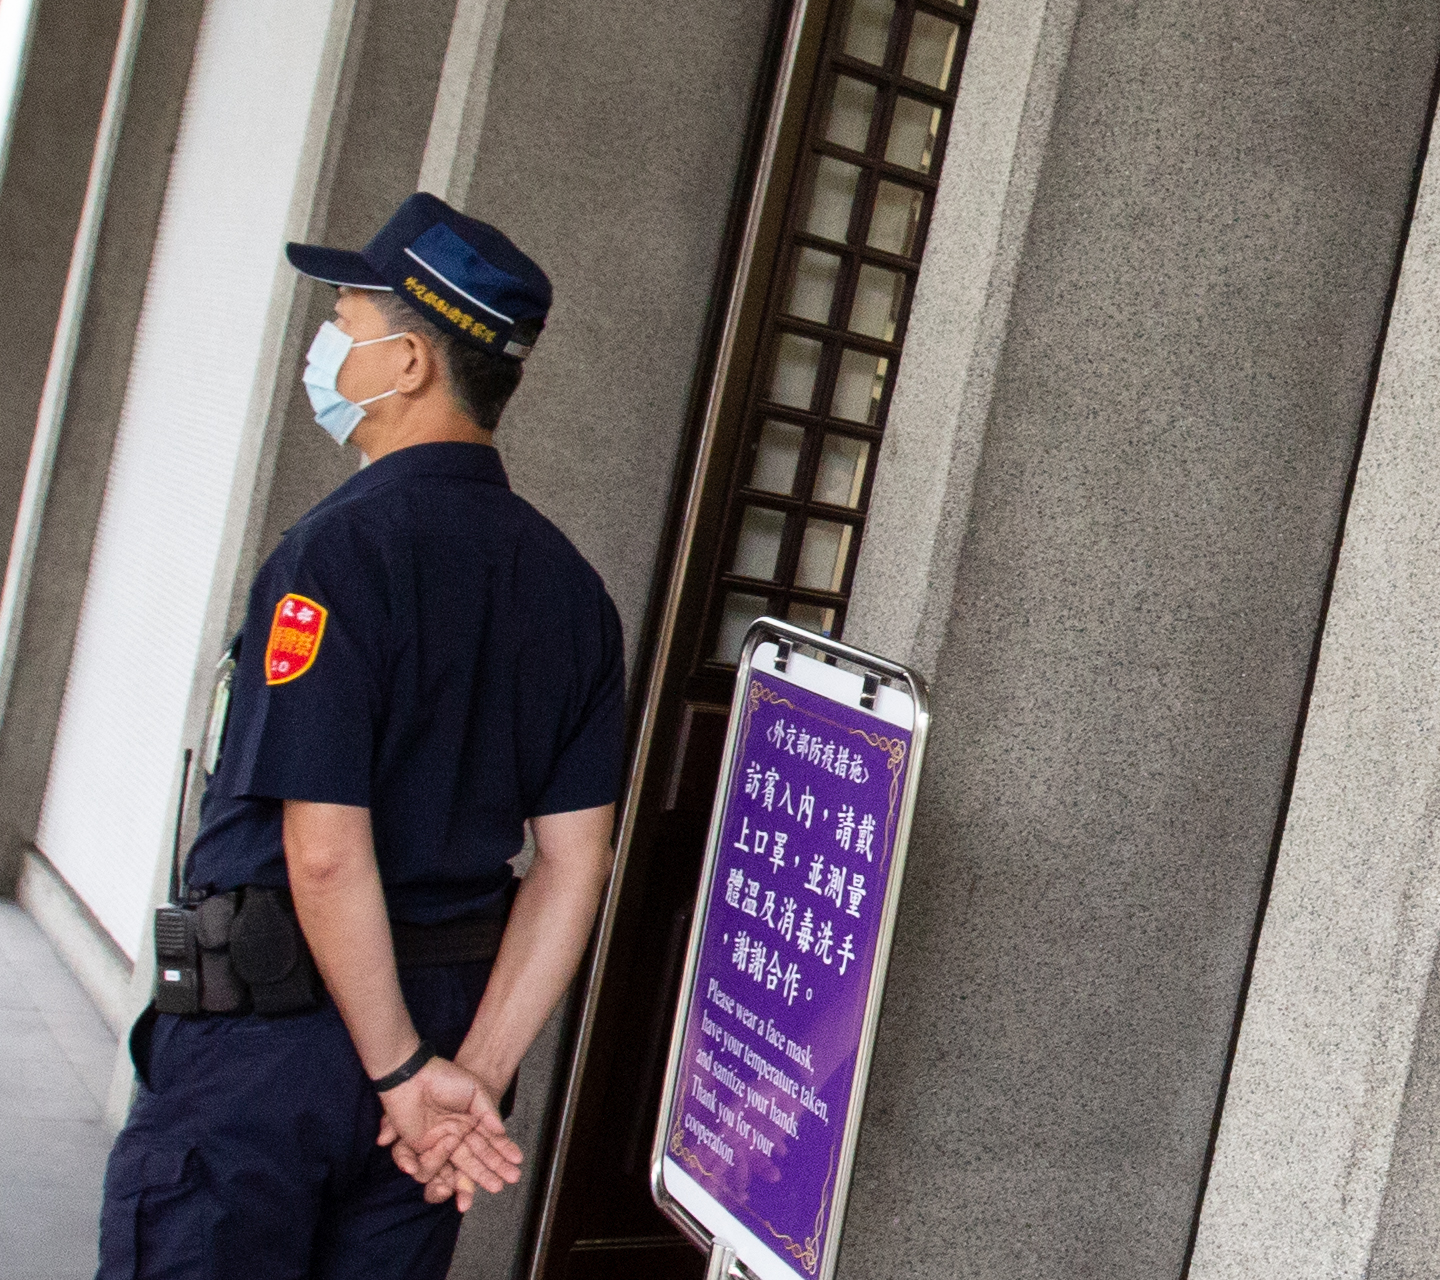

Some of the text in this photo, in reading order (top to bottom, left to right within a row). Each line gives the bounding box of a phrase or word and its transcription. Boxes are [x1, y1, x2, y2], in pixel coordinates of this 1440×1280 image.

[701, 1009, 829, 1127] have your temperature taken,
[707, 977, 814, 1075] Please wear a face mask,
[684, 1113, 735, 1167] cooperation.
[691, 1074, 775, 1158] Thank you for your
[695, 1048, 800, 1141] and sanitize your hands.
